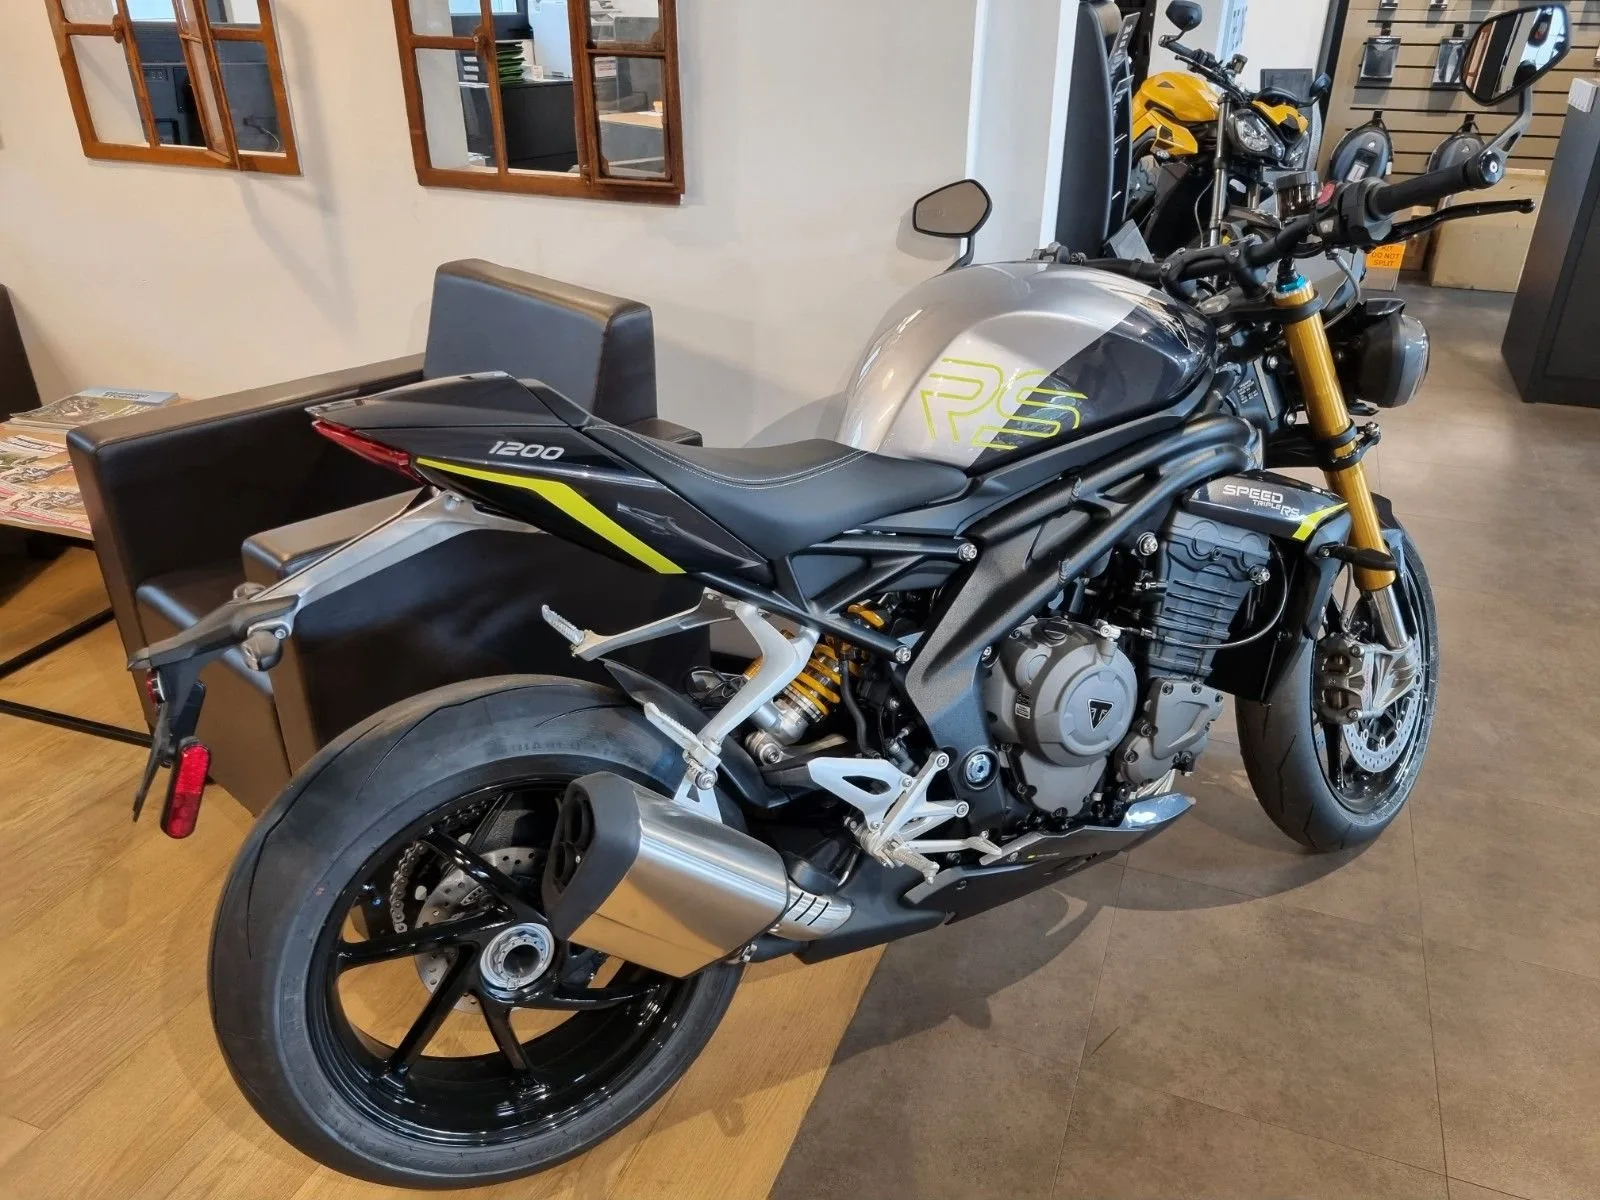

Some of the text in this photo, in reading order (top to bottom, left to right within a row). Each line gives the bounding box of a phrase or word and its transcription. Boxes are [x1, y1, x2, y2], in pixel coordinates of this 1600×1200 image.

[920, 357, 1089, 451] RS
[488, 440, 565, 460] 1200
[1222, 484, 1284, 504] SPEED
[1280, 504, 1301, 518] RS
